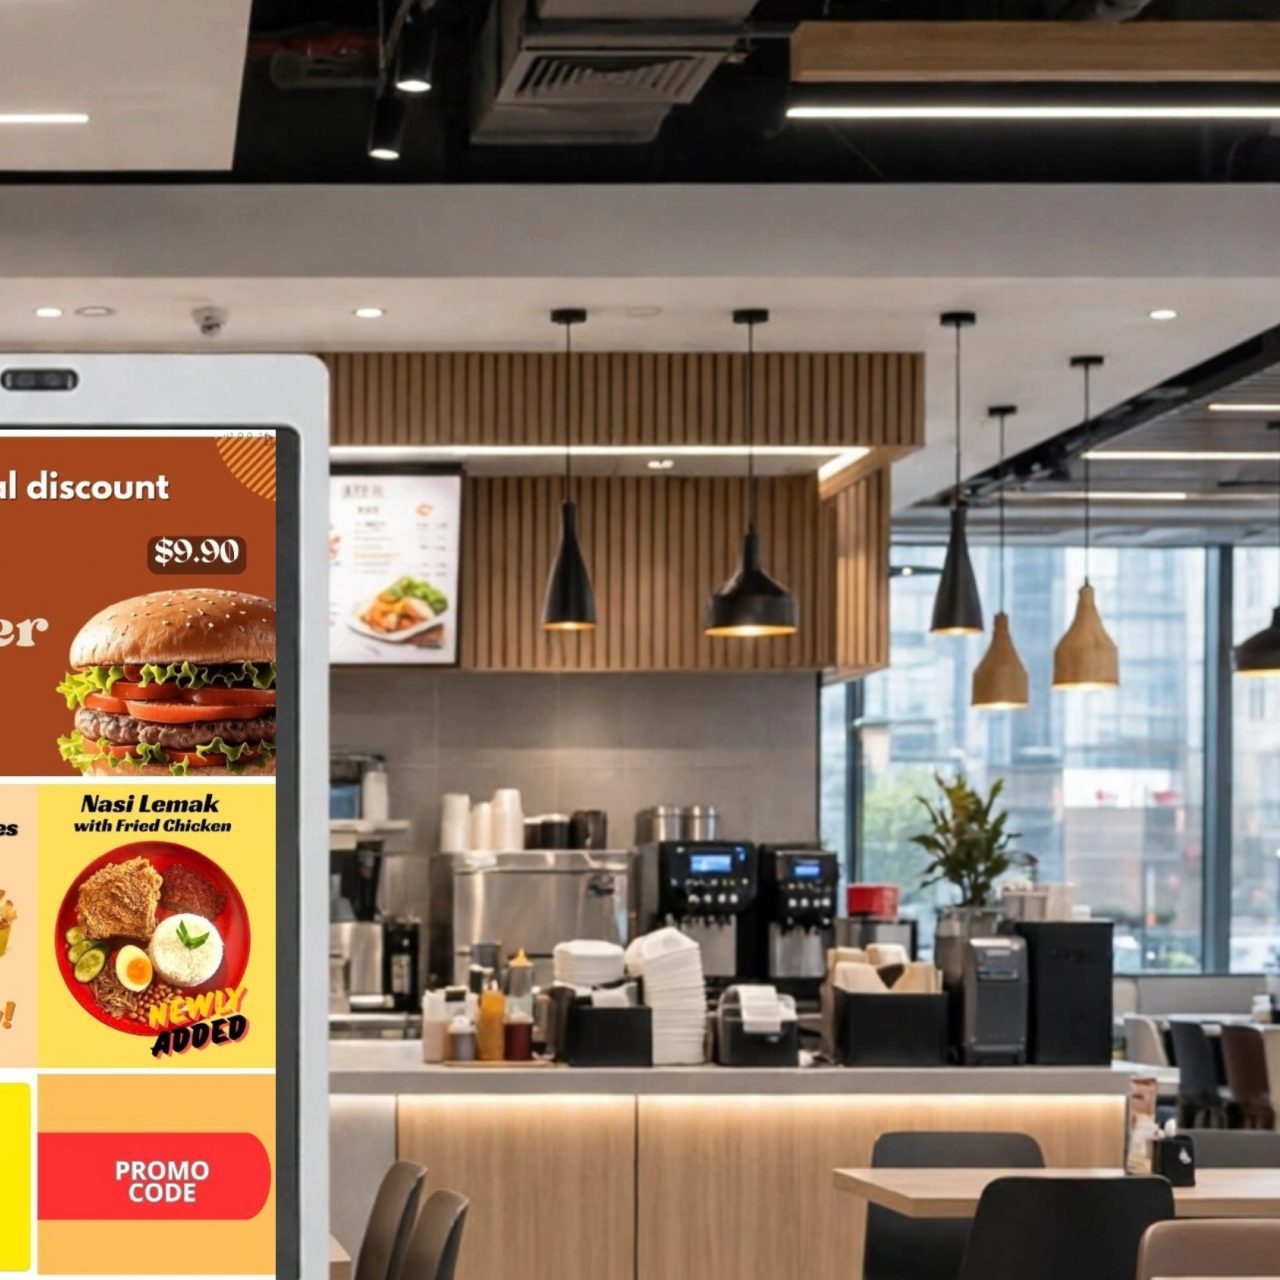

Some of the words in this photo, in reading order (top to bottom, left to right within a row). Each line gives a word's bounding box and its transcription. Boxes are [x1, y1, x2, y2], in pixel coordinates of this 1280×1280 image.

[26, 469, 169, 500] discount
[154, 537, 239, 567] $9.90
[80, 793, 135, 813] Nasi
[138, 793, 219, 813] Lemak
[74, 818, 113, 832] with
[115, 818, 160, 832] Fried
[163, 818, 232, 832] Chicken
[149, 986, 247, 1030] NEWLY
[150, 1014, 250, 1059] ADDED
[115, 1159, 210, 1182] PROMO
[128, 1182, 196, 1203] CODE
